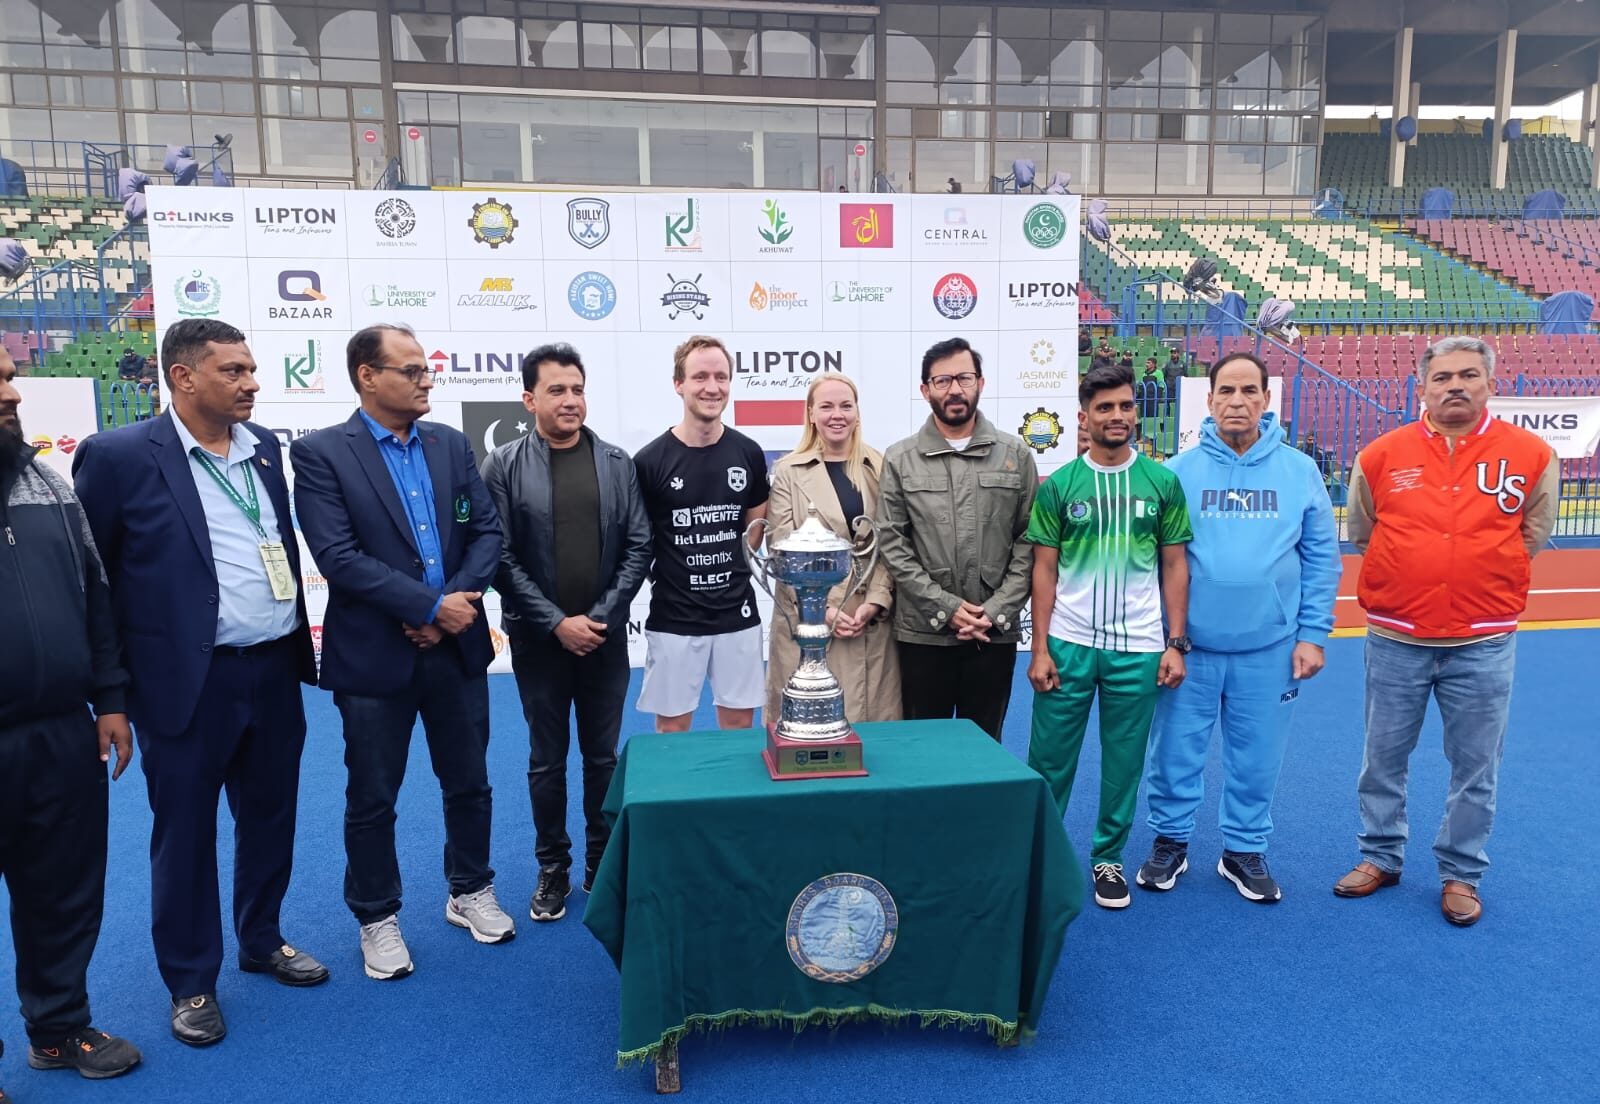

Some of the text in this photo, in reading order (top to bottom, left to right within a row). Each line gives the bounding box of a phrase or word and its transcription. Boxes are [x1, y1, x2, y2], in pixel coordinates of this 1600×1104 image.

[256, 207, 336, 224] LIPTON
[575, 208, 602, 221] BULLY
[924, 229, 988, 240] CENTRAL
[759, 246, 794, 254] AKHUWAT
[197, 280, 210, 292] HEC
[769, 284, 781, 292] the
[1009, 282, 1080, 298] LIPTON
[456, 294, 531, 307] MALIK
[769, 291, 798, 299] noor
[849, 294, 885, 302] LAHORE
[387, 298, 428, 307] LAHORE
[769, 299, 808, 311] project
[268, 307, 333, 319] BAZAAR
[735, 350, 842, 373] LIPTON
[448, 376, 503, 386] Management
[1016, 370, 1069, 380] JASMINE
[740, 375, 767, 389] Teas
[770, 377, 788, 387] and
[1023, 381, 1061, 389] GRAND
[1496, 414, 1578, 430] INKS
[1200, 489, 1278, 511] PUMA
[692, 510, 740, 525] TWENTE
[674, 534, 694, 545] Het
[689, 570, 732, 585] ELECT
[741, 599, 751, 618] 6
[789, 886, 817, 928] SPORTS
[824, 876, 865, 888] BOARD
